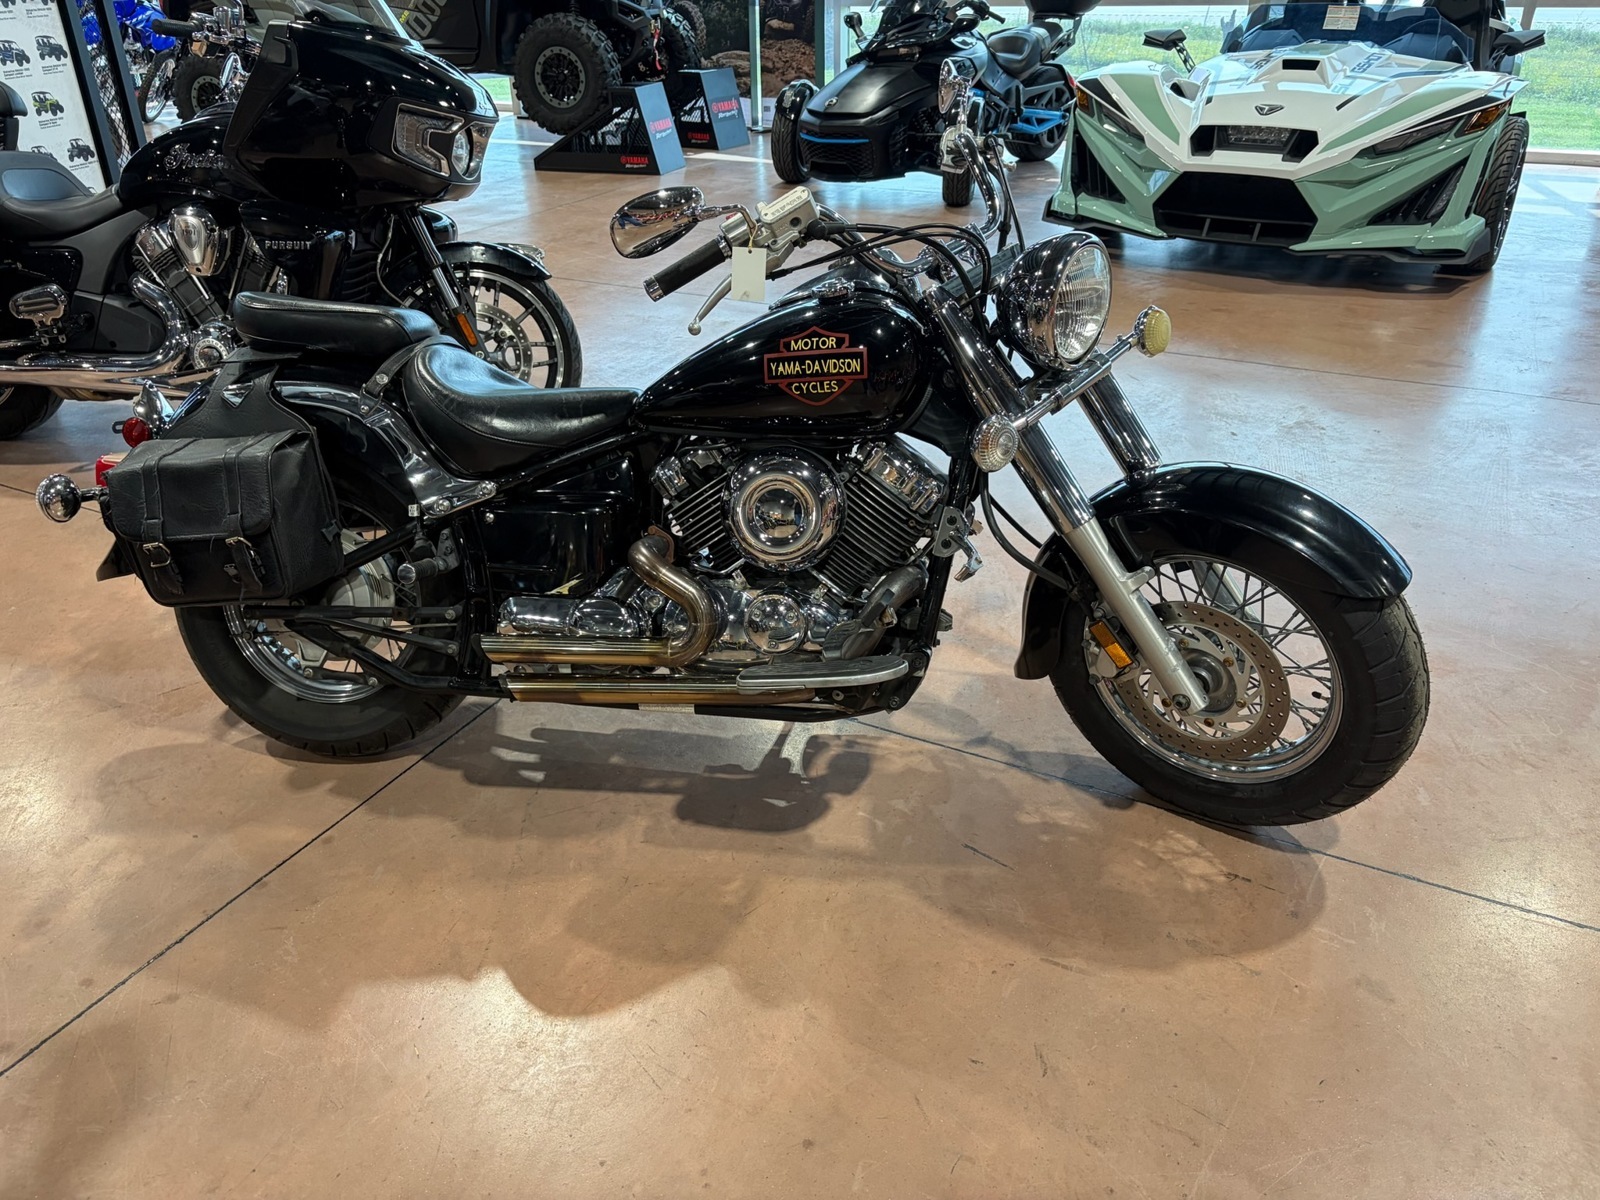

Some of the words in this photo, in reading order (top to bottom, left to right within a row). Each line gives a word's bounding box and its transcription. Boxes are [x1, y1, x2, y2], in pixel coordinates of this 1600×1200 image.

[626, 156, 649, 164] YAMAHA
[265, 240, 312, 250] PURSUIT
[790, 336, 837, 351] MOTOR
[770, 358, 861, 376] YAMA-DAVIDSON
[791, 380, 839, 394] CYCLES
